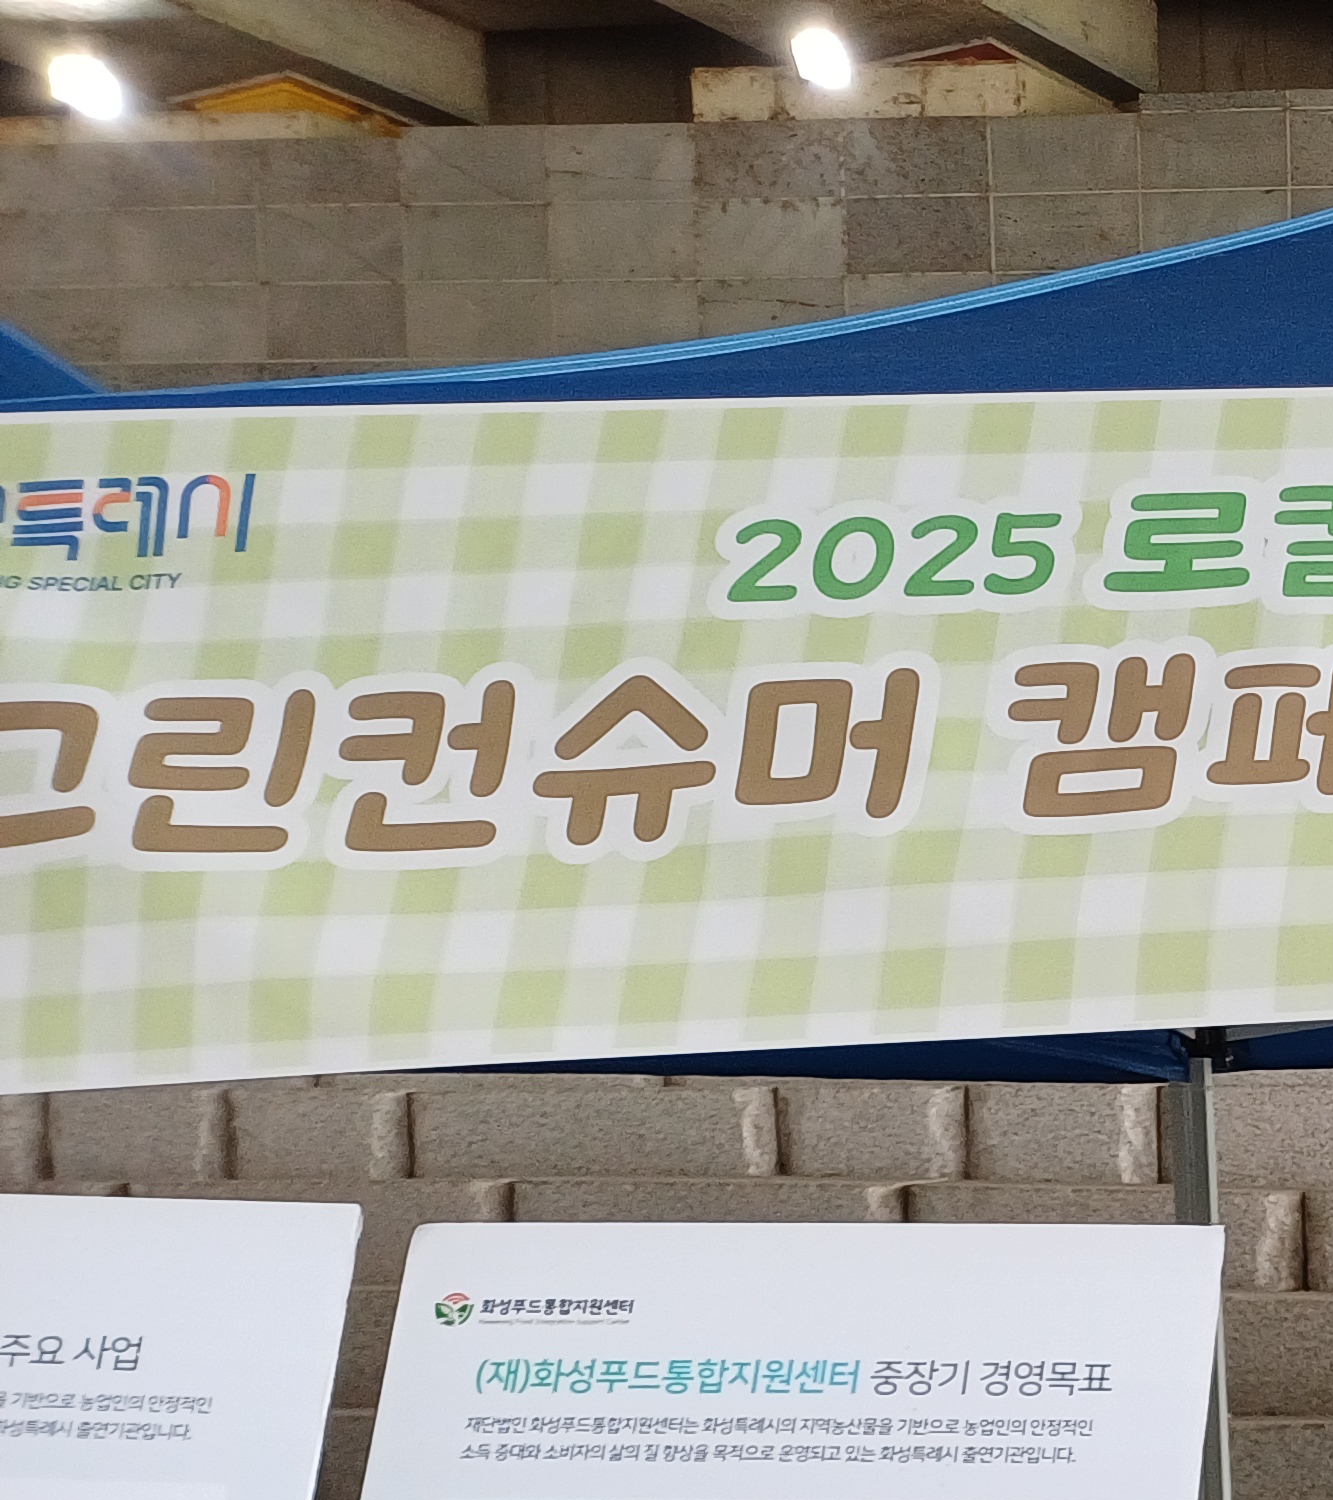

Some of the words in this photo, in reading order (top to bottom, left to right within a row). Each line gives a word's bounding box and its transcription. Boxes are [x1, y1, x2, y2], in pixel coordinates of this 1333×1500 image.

[0, 473, 256, 561] 특례시
[731, 513, 1057, 604] 2025
[28, 575, 122, 591] SPECIAL
[129, 573, 182, 589] CITY
[0, 667, 919, 853] 그린컨슈머
[72, 1335, 145, 1372] 사업
[475, 1357, 861, 1395] (재)화성푸드통합지원센터
[869, 1359, 971, 1397] 중장기
[980, 1360, 1113, 1397] 경영목표
[897, 1417, 960, 1437] 기반으로
